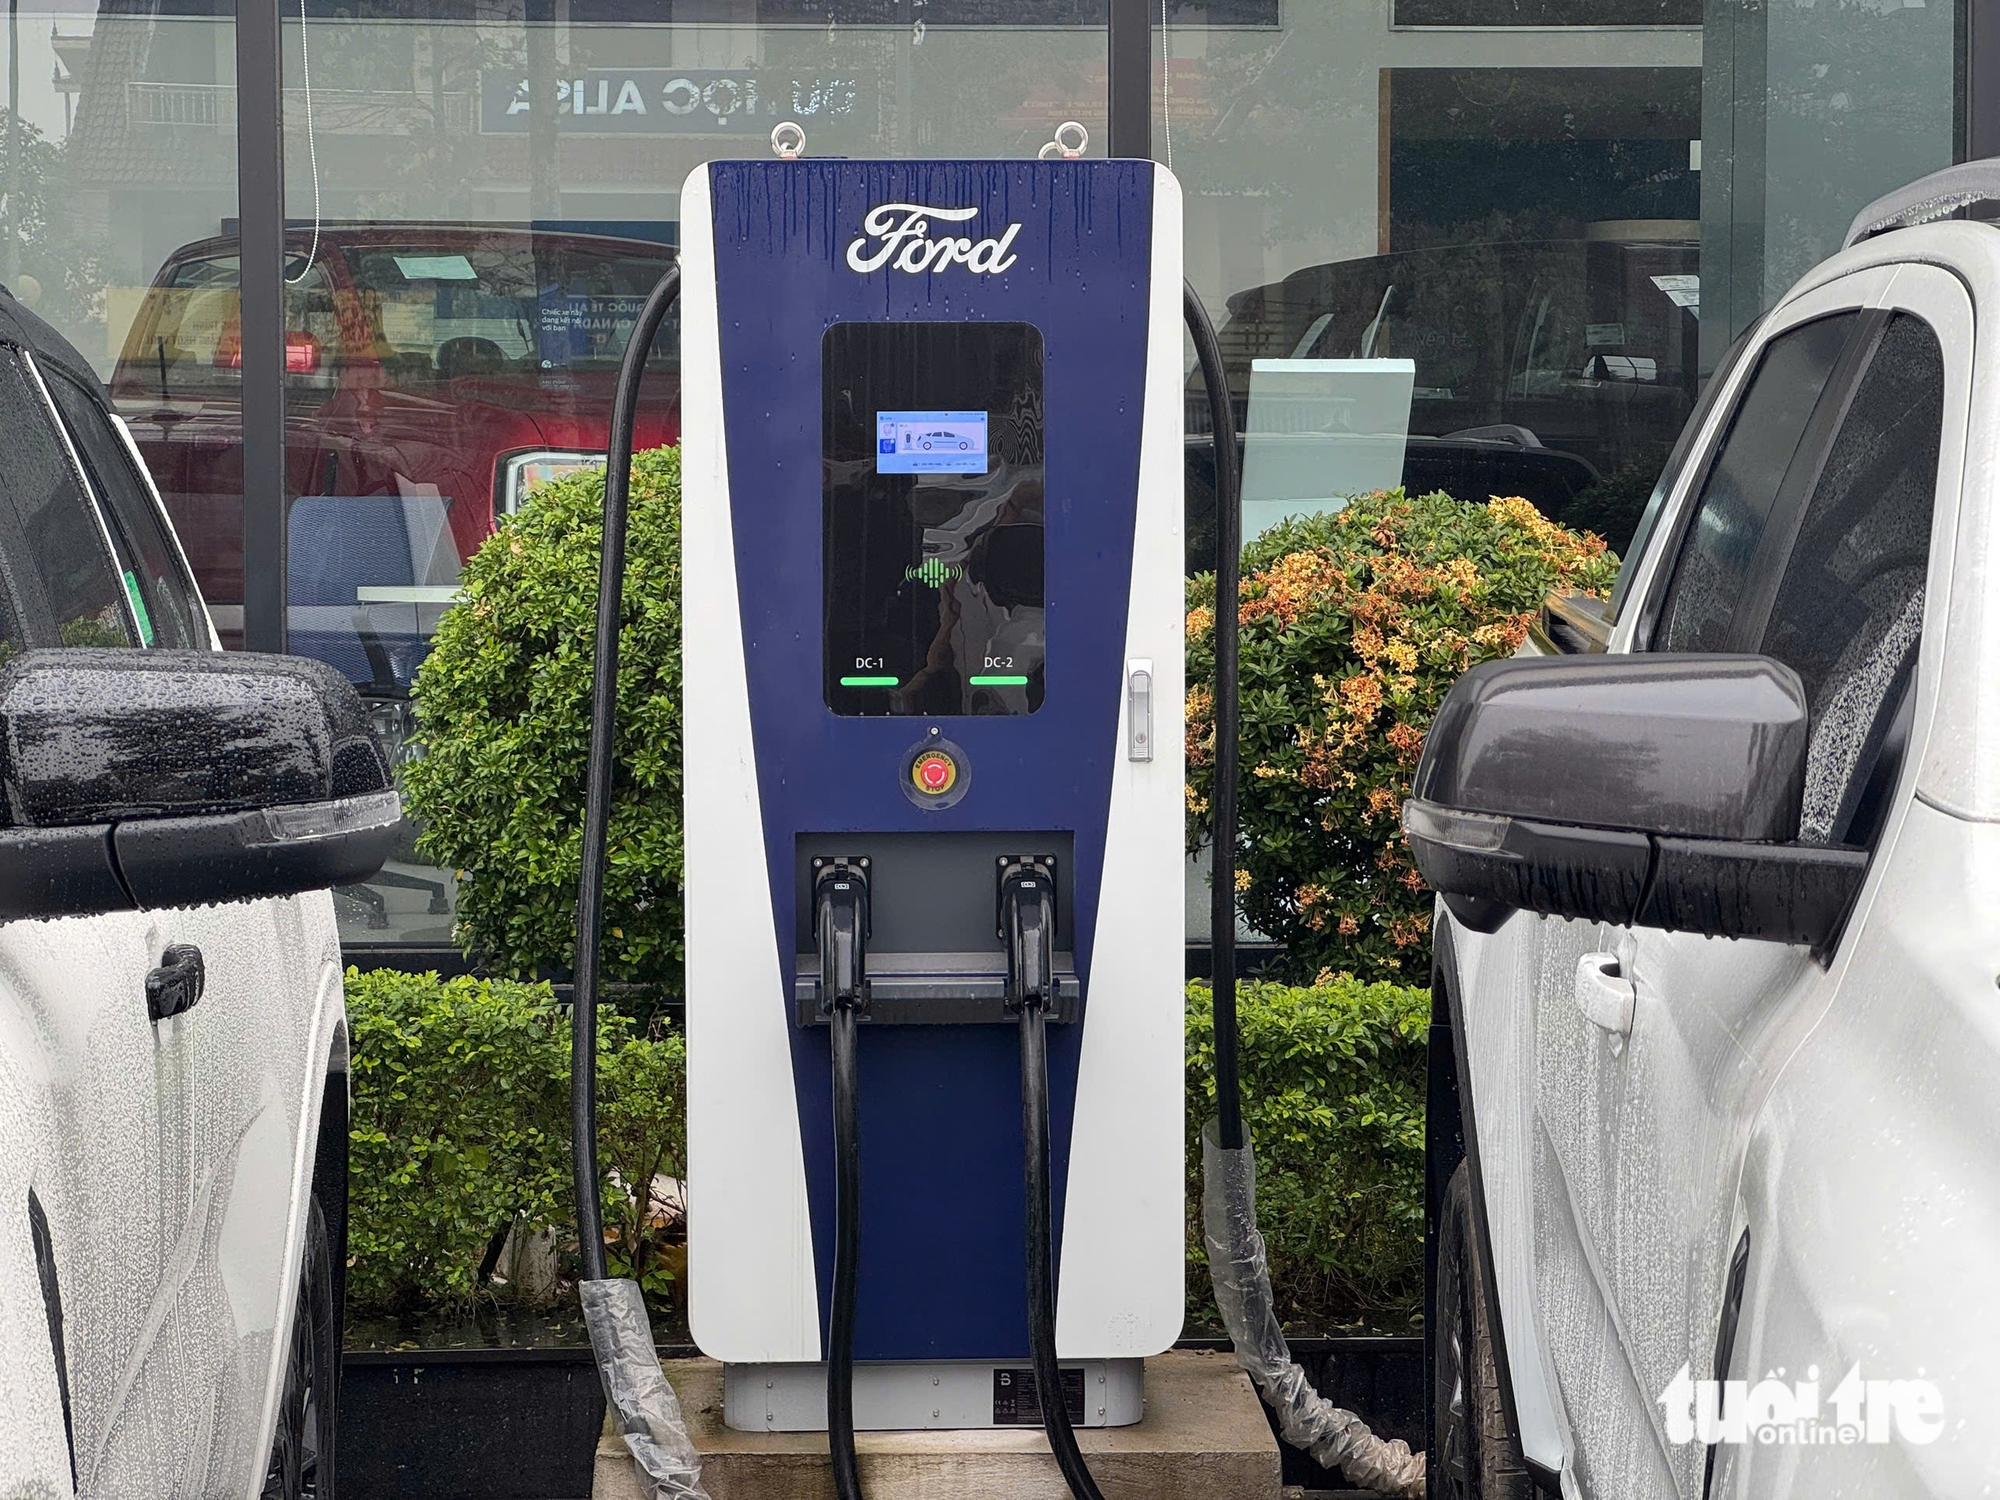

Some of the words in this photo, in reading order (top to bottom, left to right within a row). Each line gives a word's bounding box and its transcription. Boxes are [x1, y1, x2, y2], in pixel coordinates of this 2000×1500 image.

[847, 203, 1022, 274] Ford
[541, 308, 561, 316] Chiếc
[541, 316, 560, 324] đang
[553, 324, 567, 332] bạn
[855, 657, 884, 669] DC-1
[984, 656, 1013, 668] DC-2
[915, 752, 952, 769] EMERGENCY
[925, 784, 945, 792] STOP
